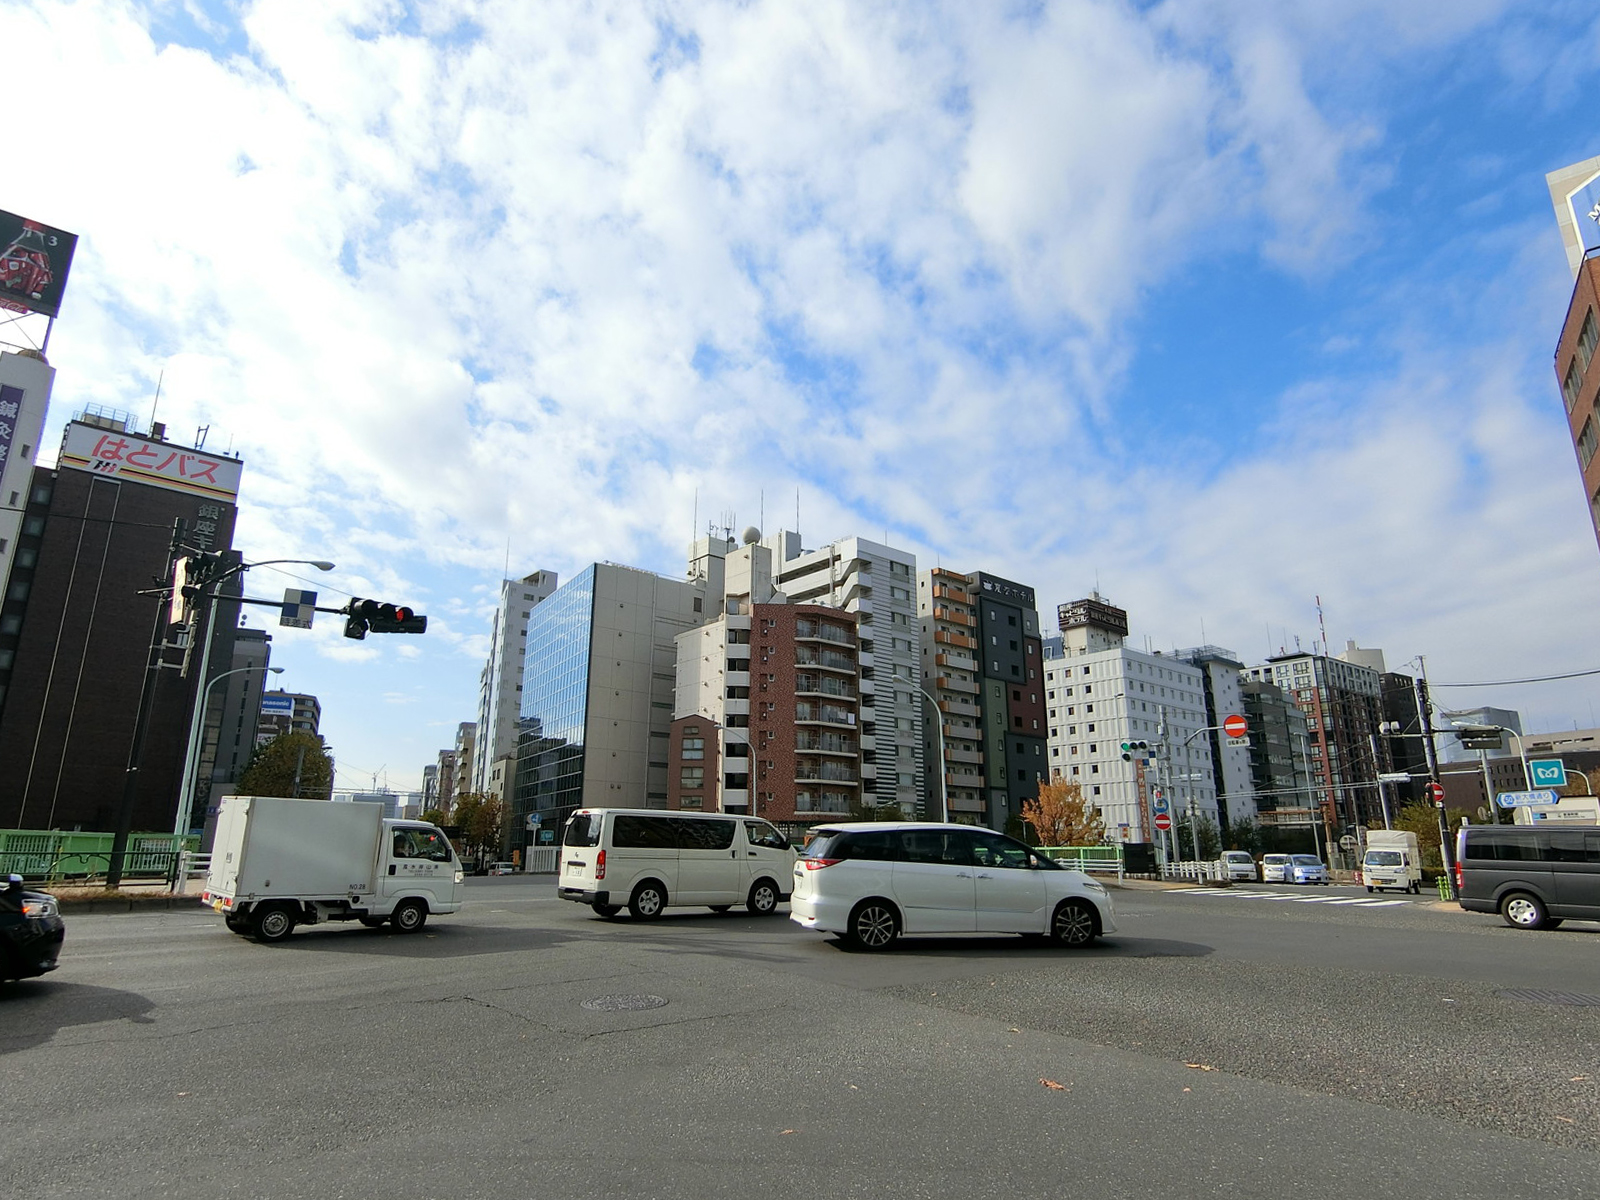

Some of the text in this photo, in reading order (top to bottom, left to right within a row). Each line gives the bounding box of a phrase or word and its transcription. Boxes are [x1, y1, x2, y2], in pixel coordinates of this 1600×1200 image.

[48, 236, 58, 246] 3
[92, 435, 221, 484] はとバス
